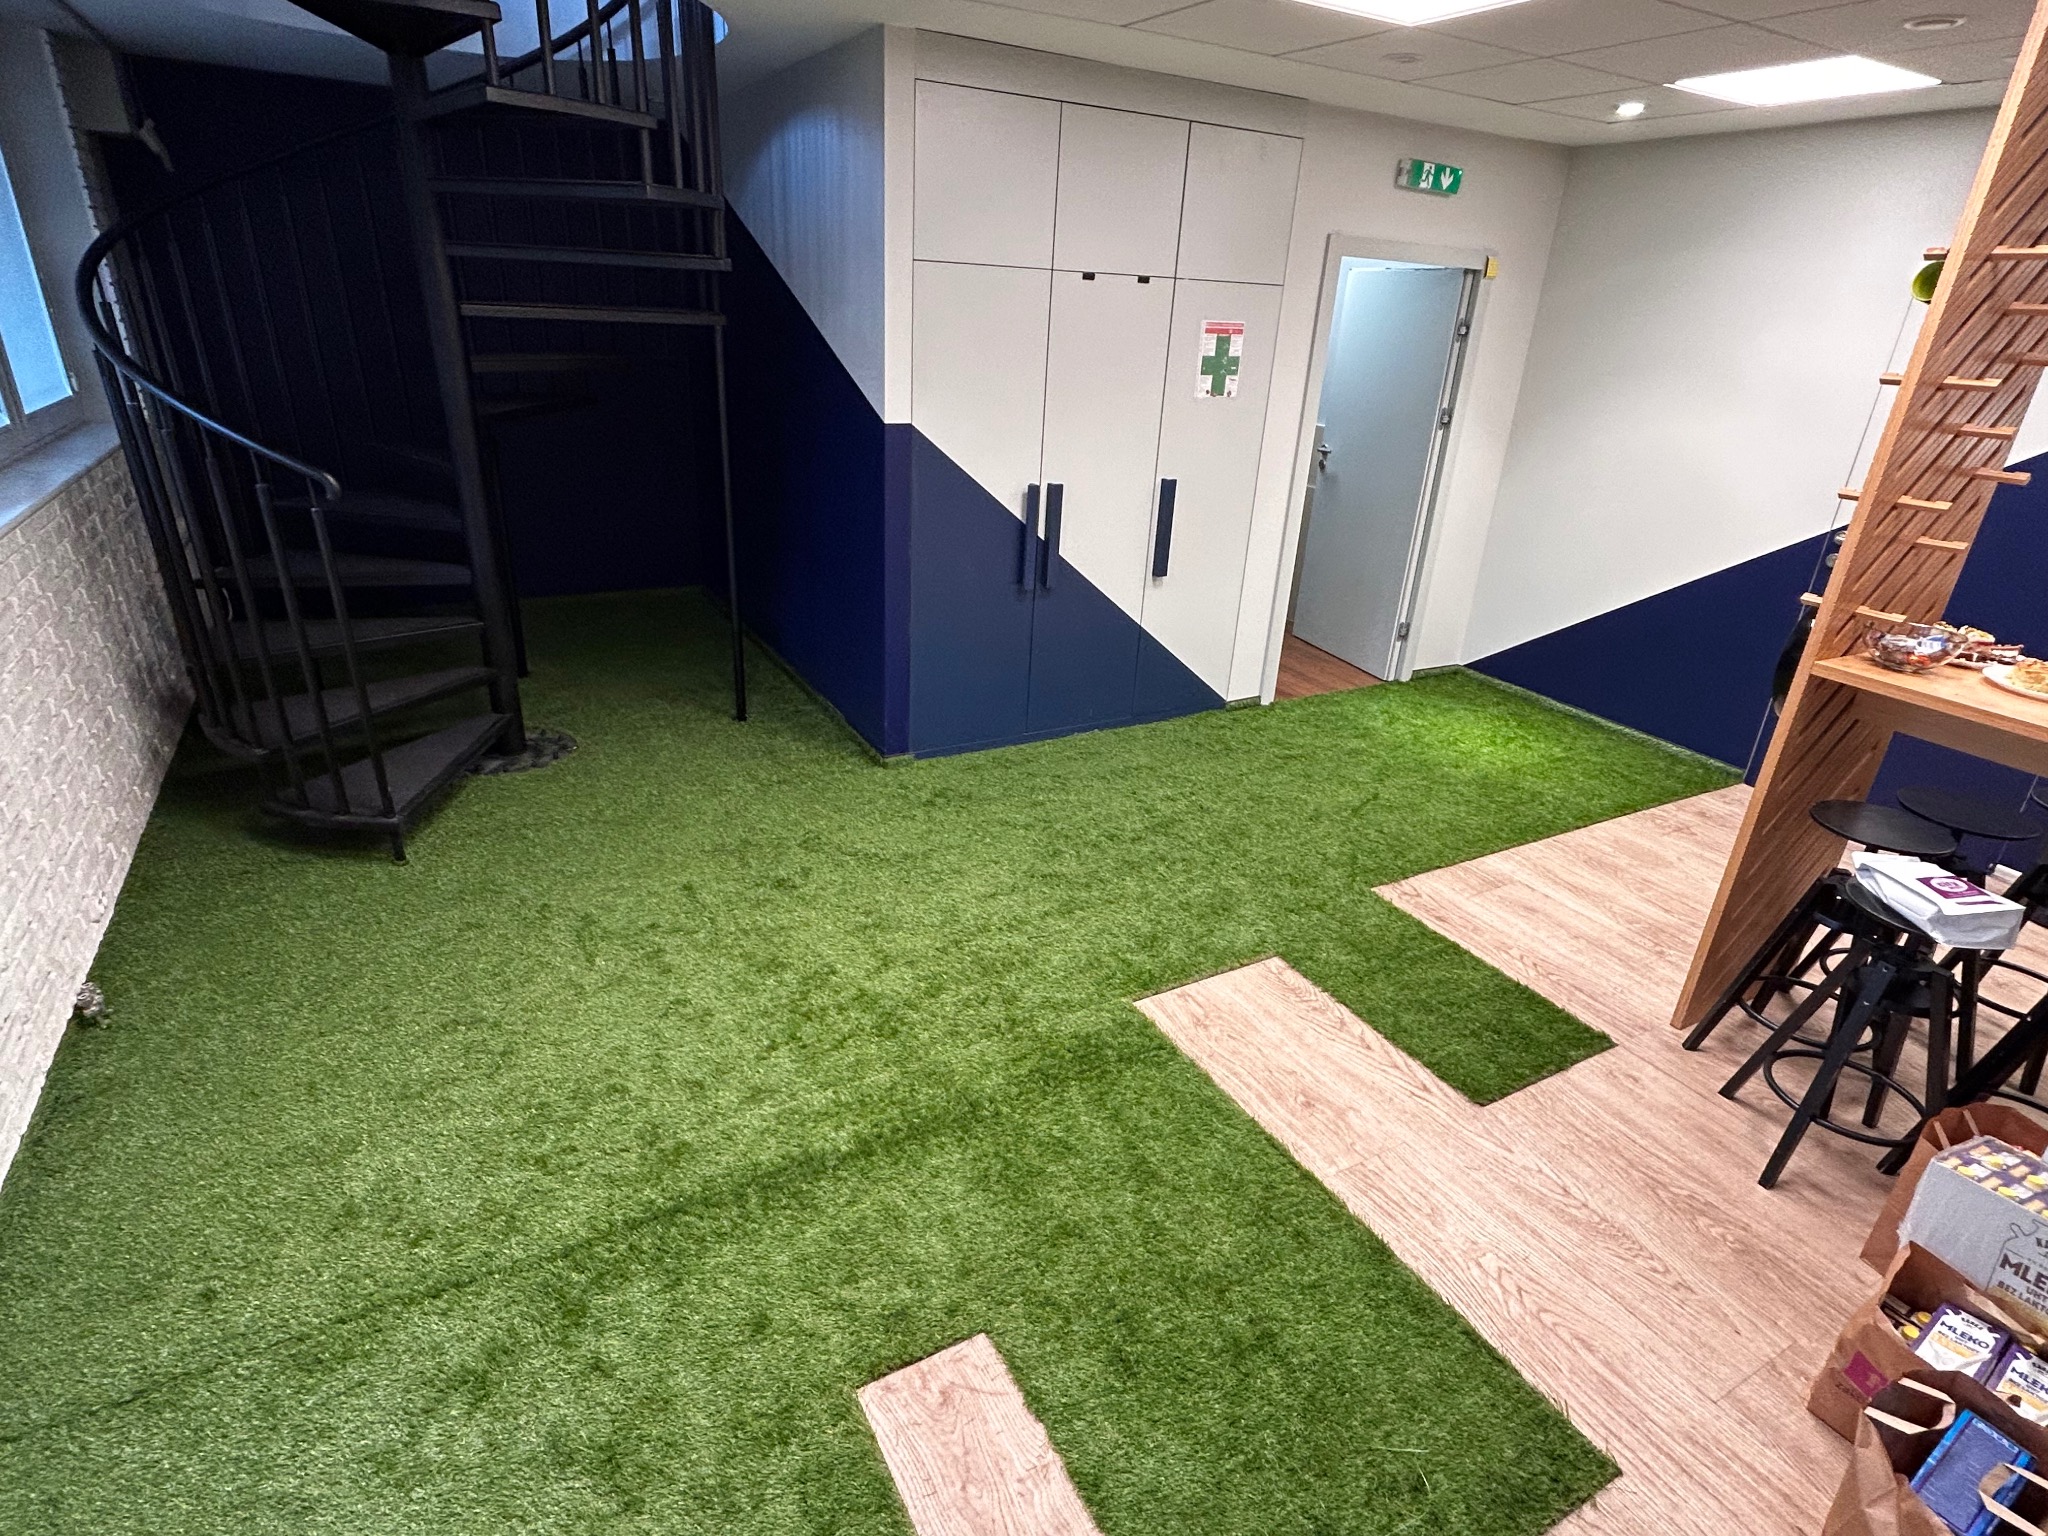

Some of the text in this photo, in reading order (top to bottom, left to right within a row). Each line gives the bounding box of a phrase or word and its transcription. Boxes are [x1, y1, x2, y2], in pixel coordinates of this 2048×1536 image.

[1999, 1252, 2048, 1291] MLE
[2018, 1292, 2048, 1315] LAKT
[1940, 1321, 1989, 1349] MLEKO
